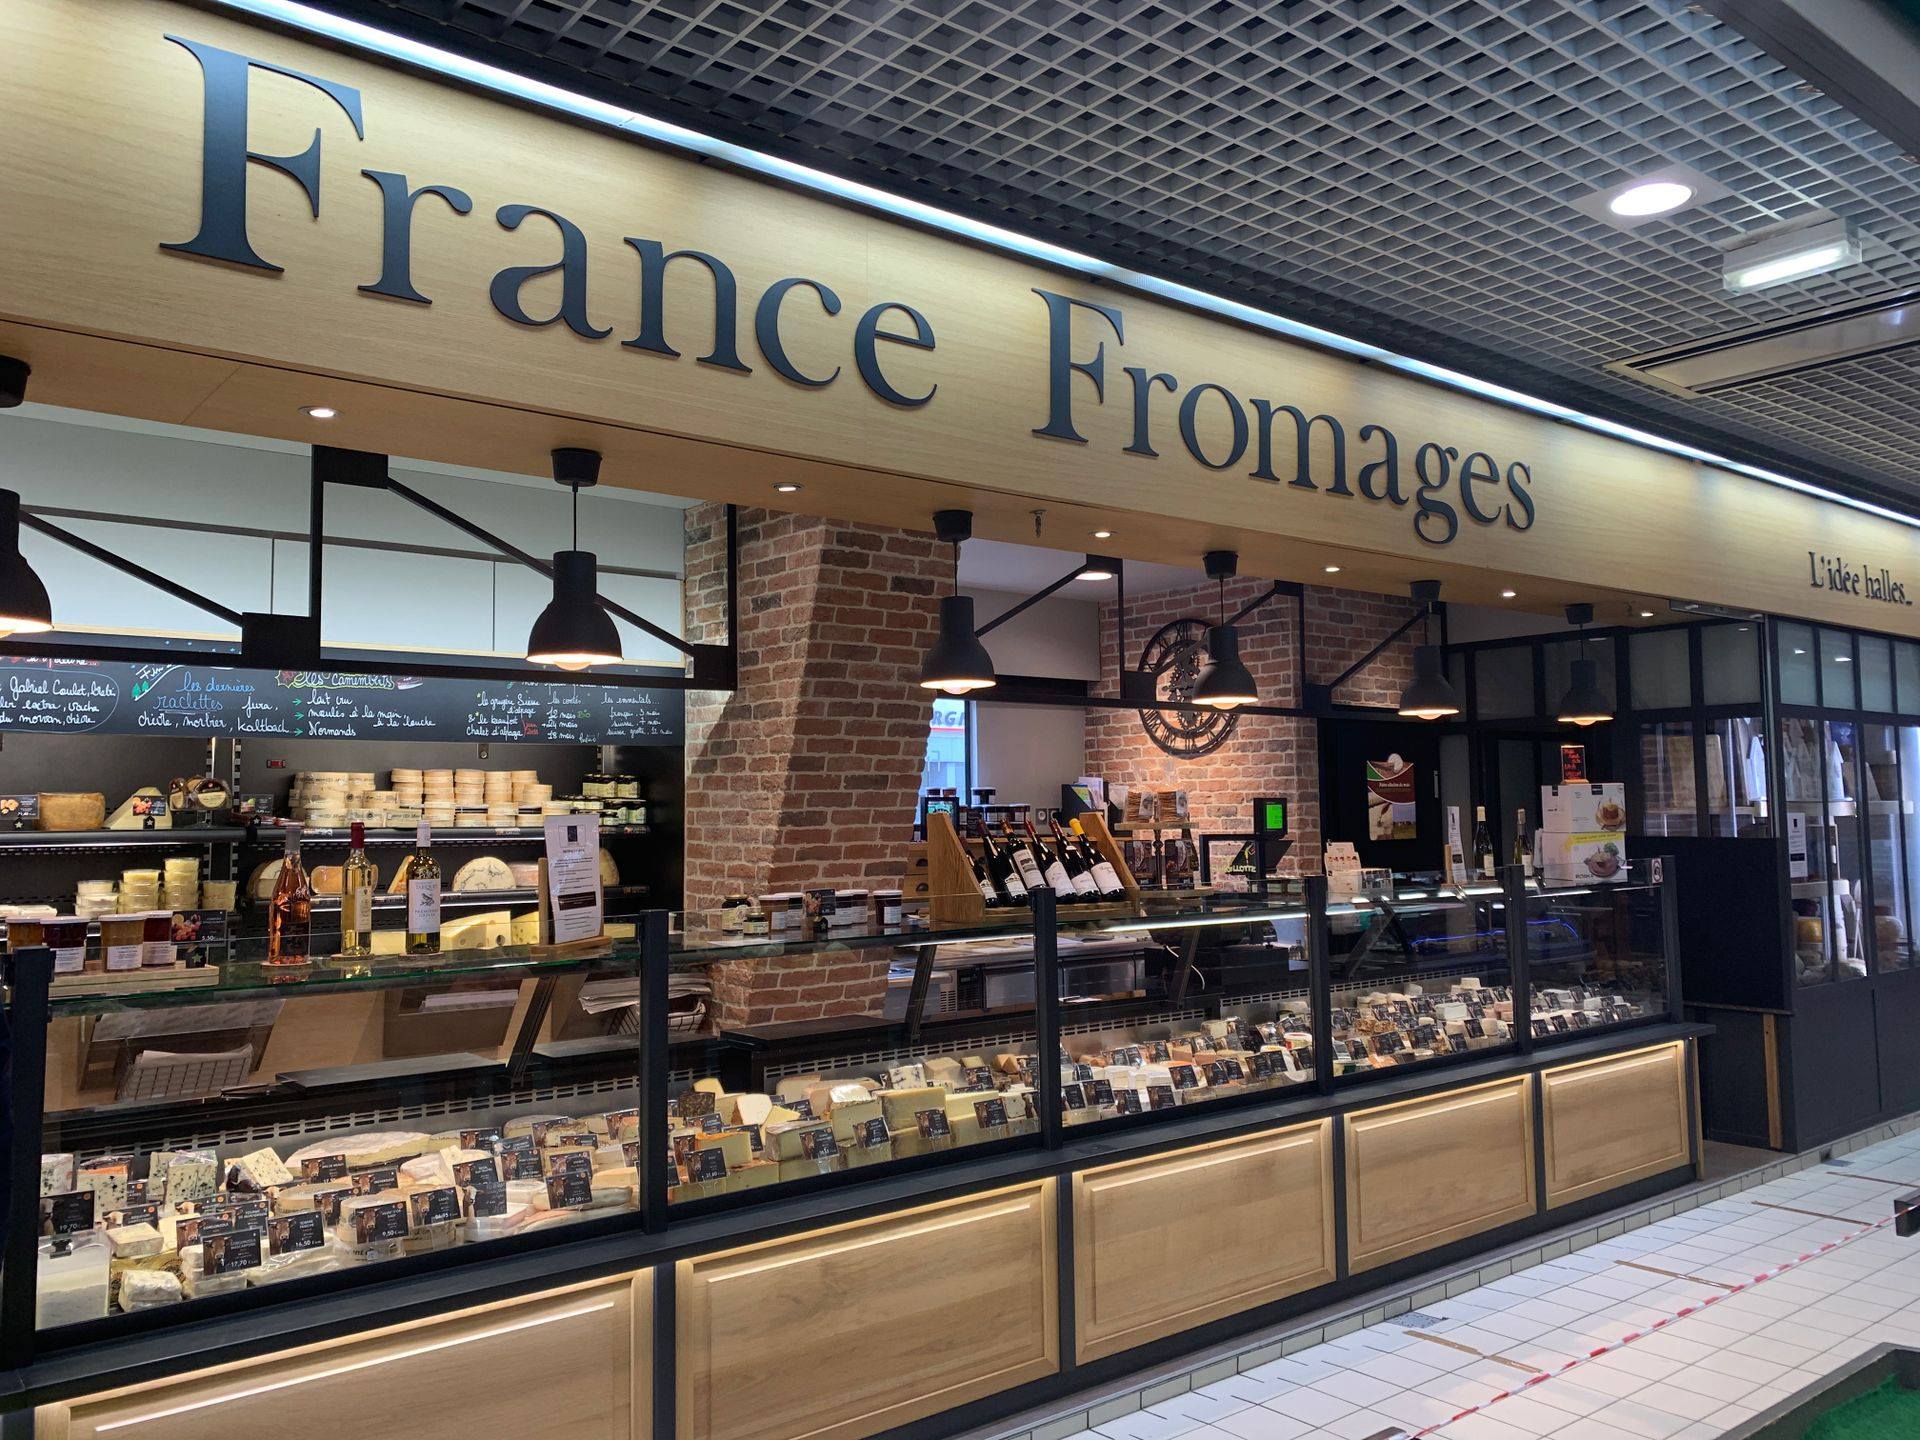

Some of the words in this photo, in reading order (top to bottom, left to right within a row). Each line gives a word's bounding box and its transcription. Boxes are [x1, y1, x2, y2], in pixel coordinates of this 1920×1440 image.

[160, 33, 938, 408] France
[1031, 287, 1535, 545] Fromages
[1808, 551, 1860, 595] L'idée
